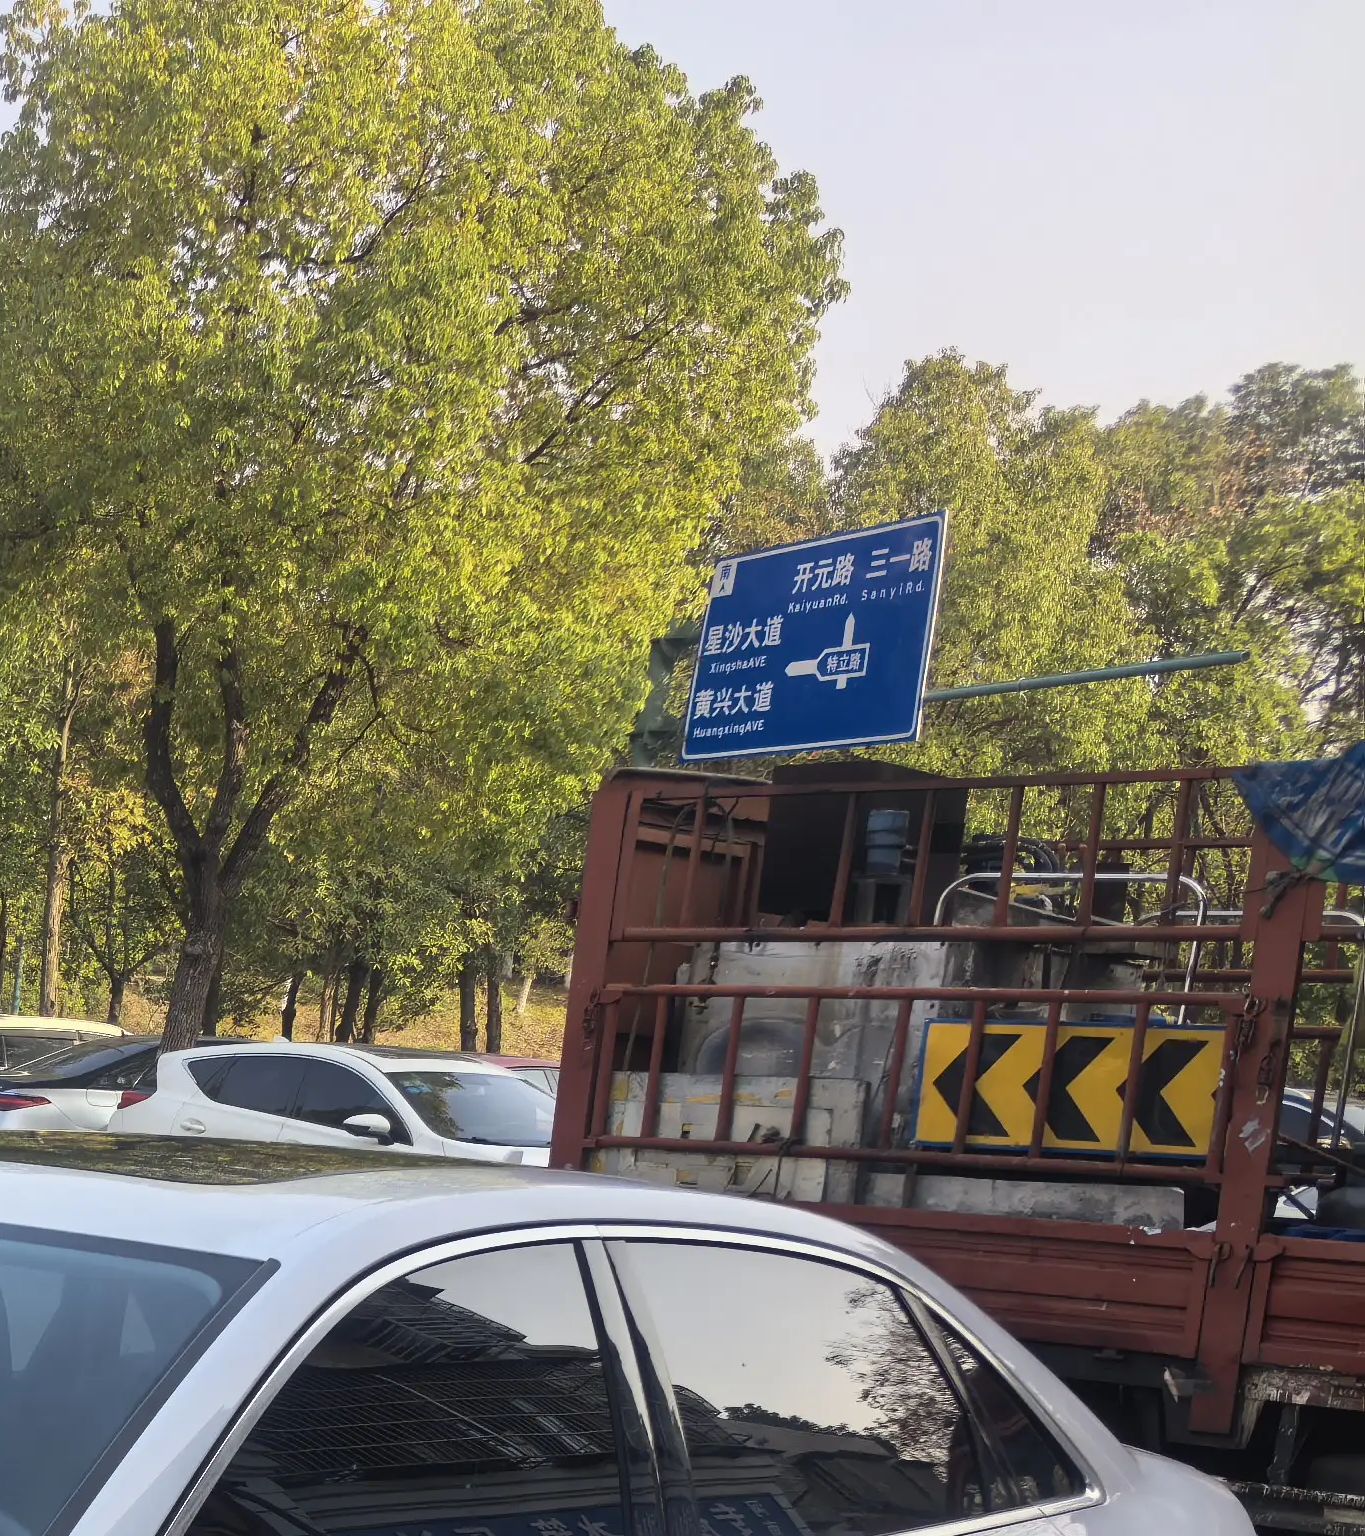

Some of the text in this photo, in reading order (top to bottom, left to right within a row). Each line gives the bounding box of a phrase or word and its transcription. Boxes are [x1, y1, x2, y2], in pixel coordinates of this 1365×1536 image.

[791, 537, 933, 595] 开元路 三一路
[703, 614, 784, 656] 星沙大道
[826, 652, 861, 672] 特立路
[693, 681, 774, 719] 黄兴大道
